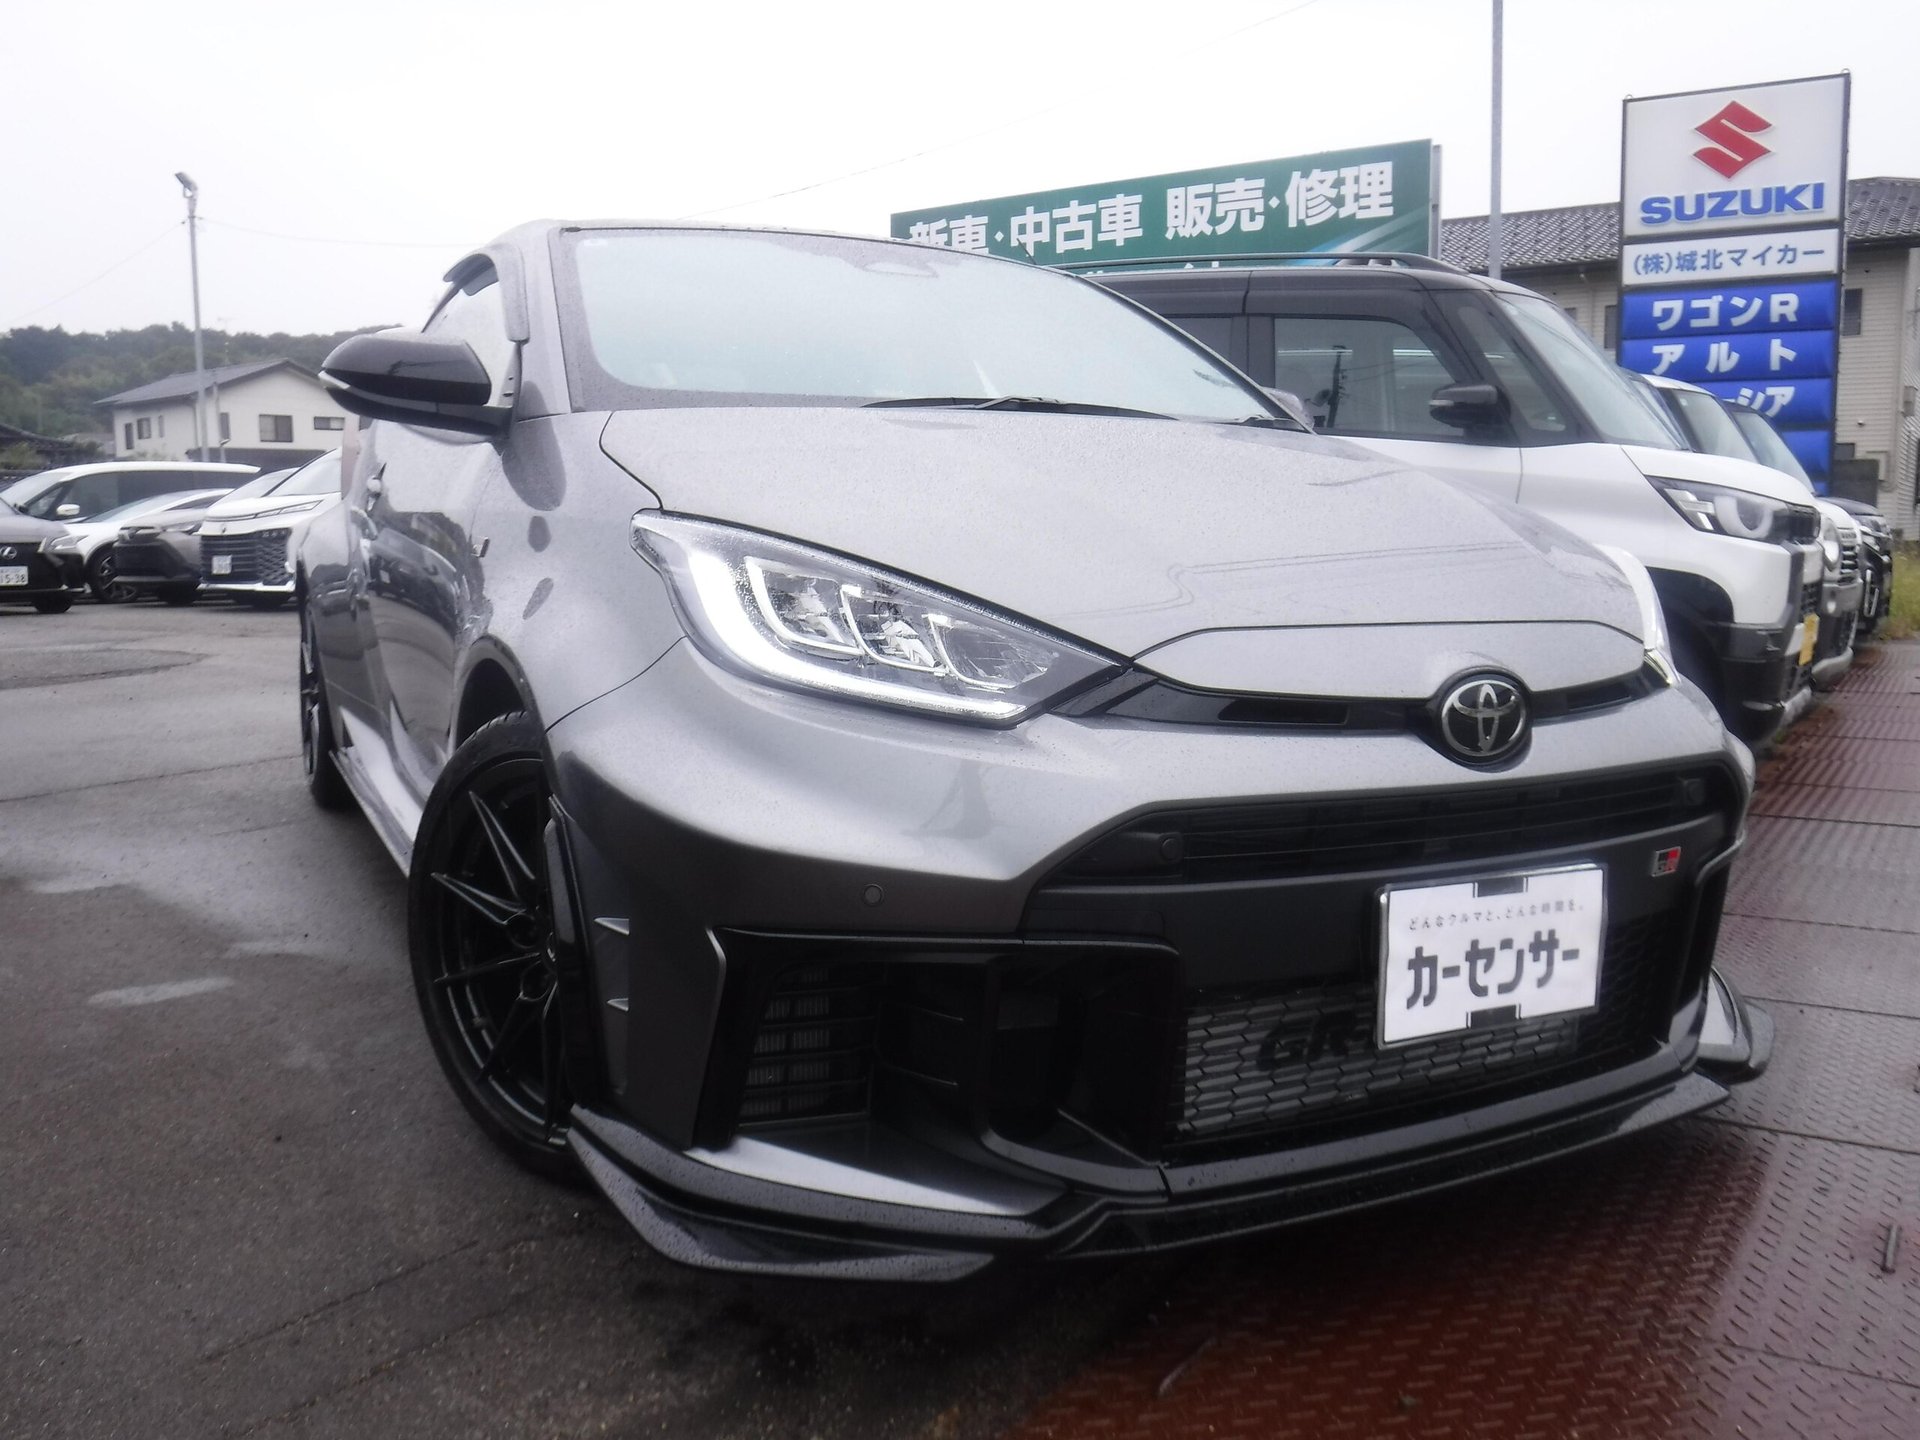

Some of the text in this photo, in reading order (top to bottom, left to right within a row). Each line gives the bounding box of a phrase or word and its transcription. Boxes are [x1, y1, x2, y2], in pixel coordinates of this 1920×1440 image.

[1165, 161, 1394, 239] 販売・修理
[1640, 182, 1825, 225] SUZUKI
[1652, 292, 1799, 331] ワゴンR
[1652, 338, 1797, 375] アルト
[1406, 929, 1579, 1010] カーセンサー
